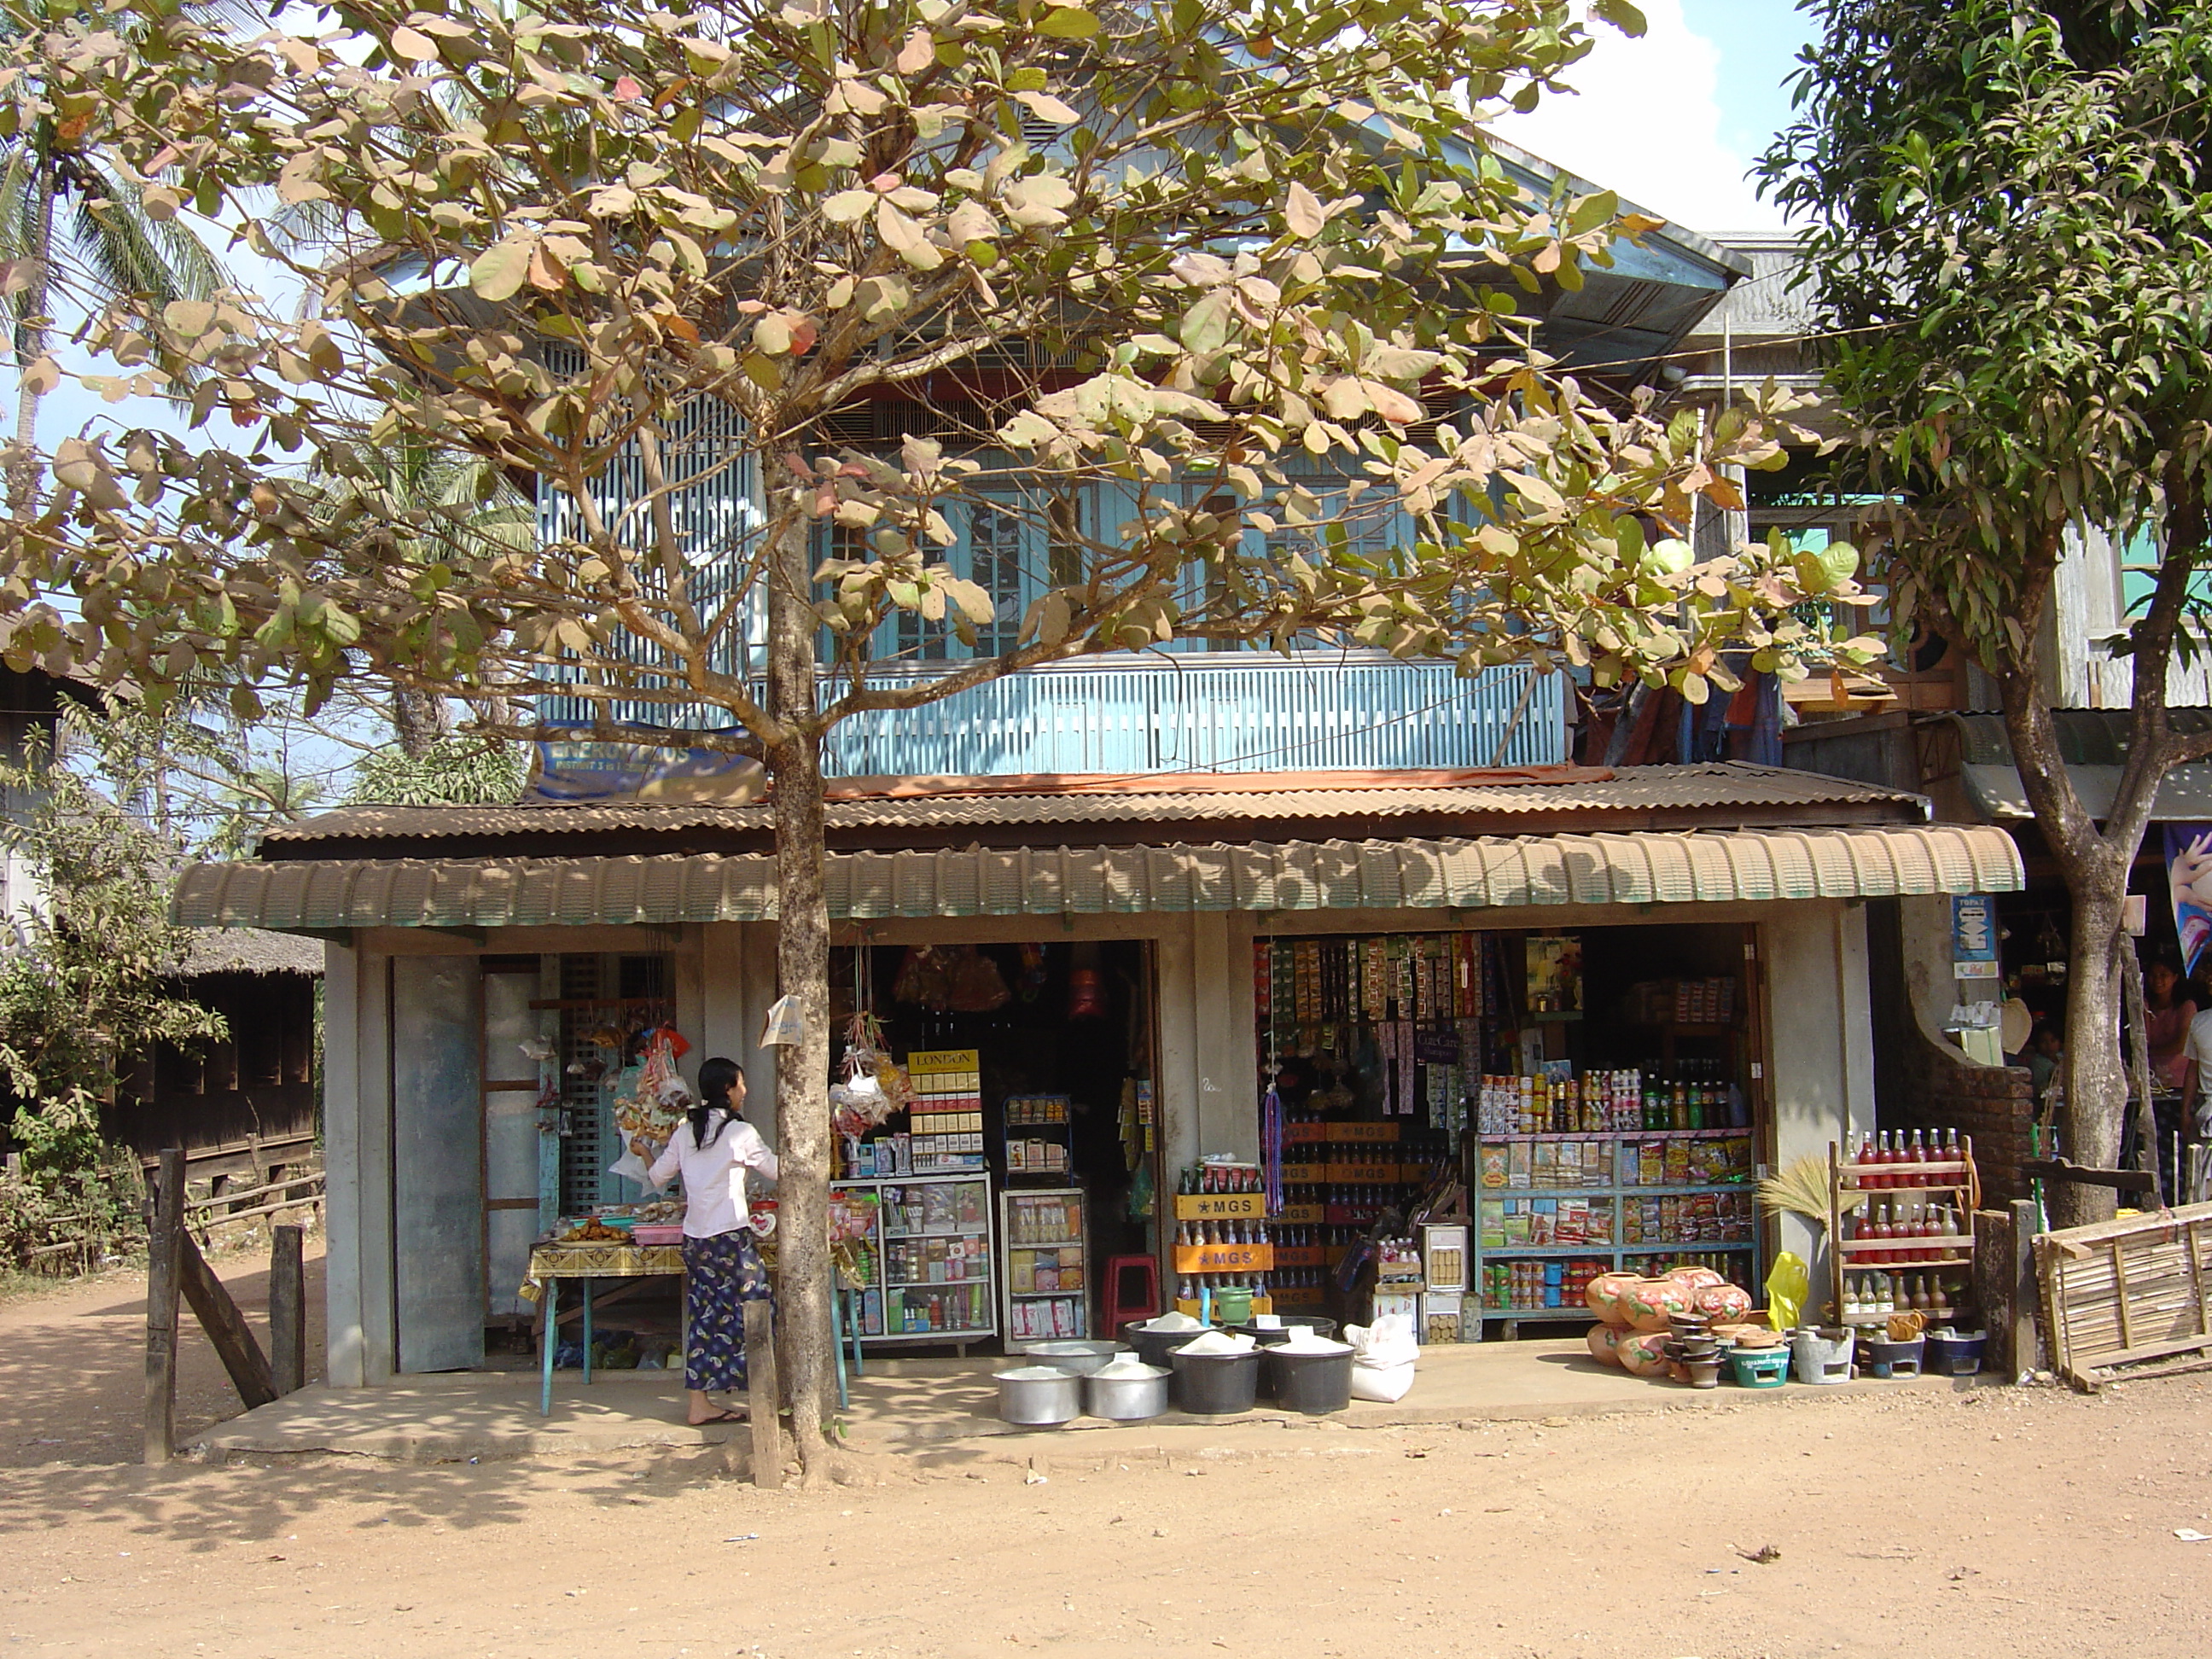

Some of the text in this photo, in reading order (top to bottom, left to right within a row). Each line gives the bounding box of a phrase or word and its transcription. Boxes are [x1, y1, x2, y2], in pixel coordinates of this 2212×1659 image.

[916, 1053, 970, 1066] LONDON
[1354, 1126, 1386, 1138] MGS
[1354, 1167, 1386, 1179] MGS
[1214, 1200, 1252, 1213] MGS
[1214, 1251, 1252, 1265] MGS
